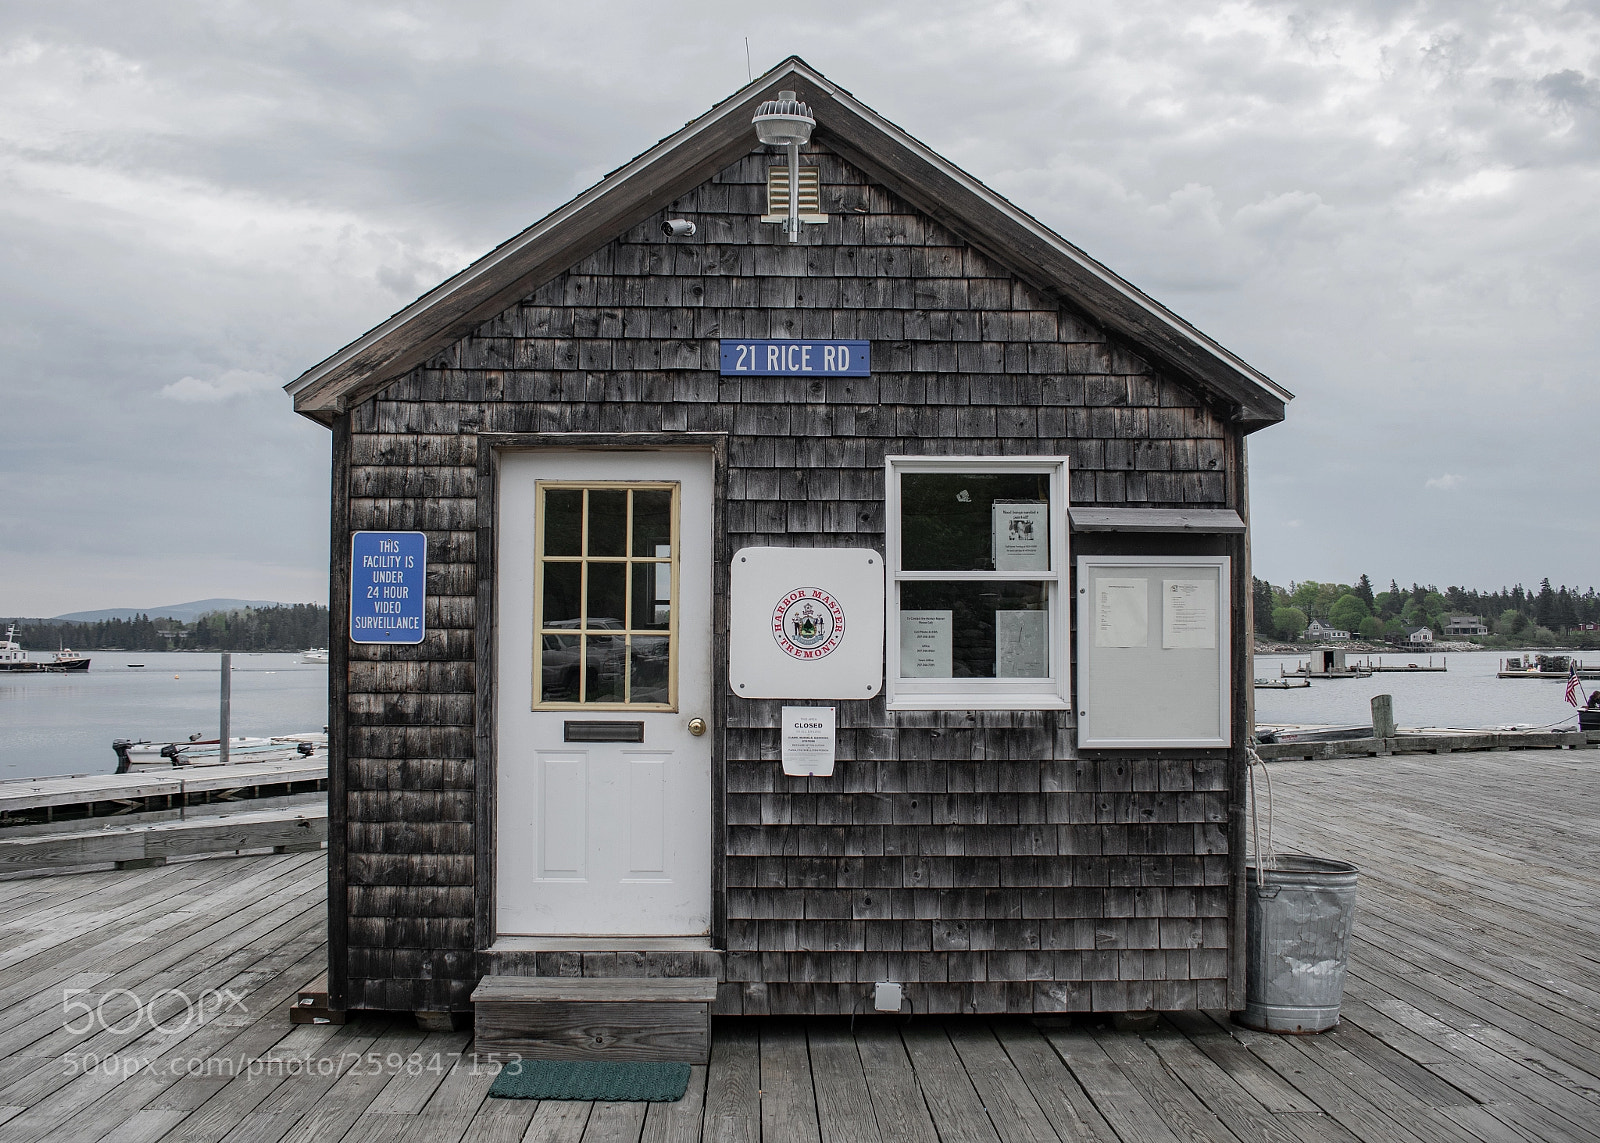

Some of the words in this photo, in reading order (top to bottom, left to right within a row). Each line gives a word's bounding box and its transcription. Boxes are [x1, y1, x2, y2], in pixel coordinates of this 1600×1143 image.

[735, 344, 756, 371] 21
[767, 344, 813, 371] RICE
[824, 345, 850, 371] RD
[380, 540, 400, 553] THIS
[363, 555, 402, 568] FACILITY
[405, 556, 414, 568] IS
[373, 571, 404, 583] UNDER
[367, 586, 380, 599] 24
[383, 586, 409, 599] HOUR
[374, 601, 401, 614] VIDEO
[774, 590, 806, 632] HARBOR
[812, 590, 843, 632] MASTER
[355, 616, 420, 630] SURVEILLANCE
[780, 638, 836, 658] TREMONT
